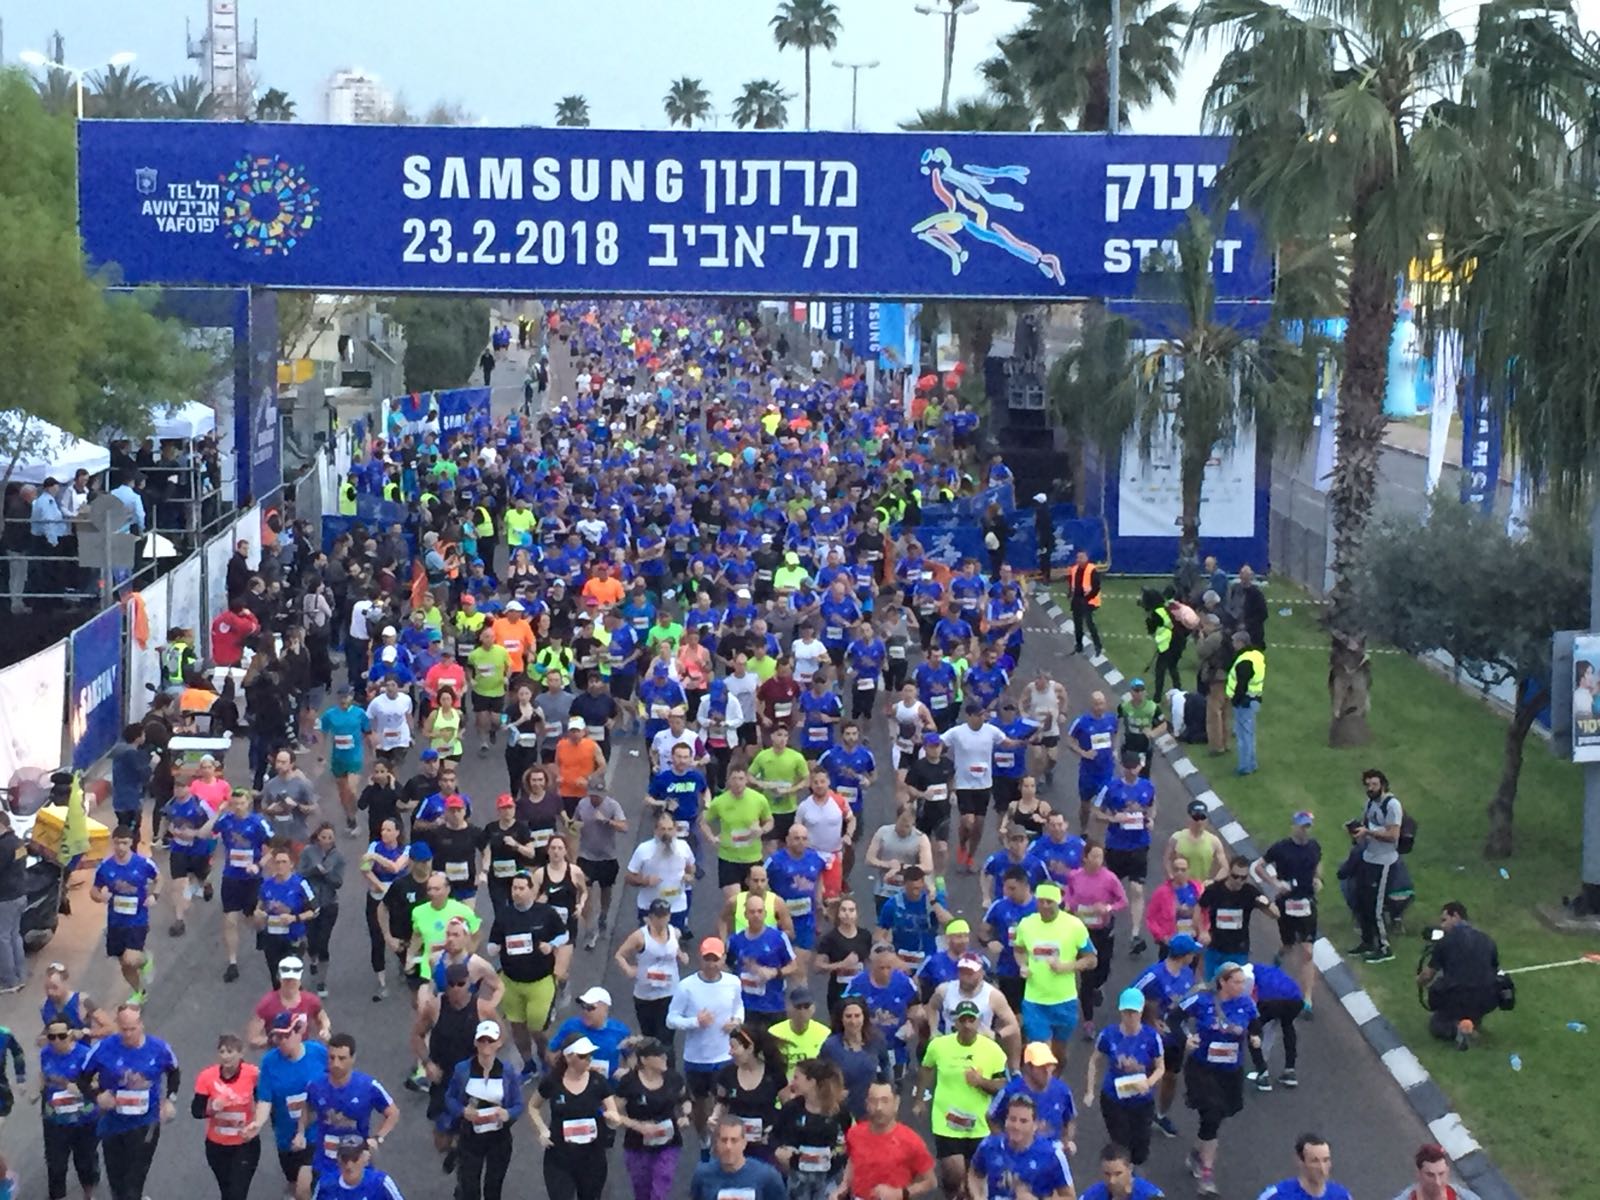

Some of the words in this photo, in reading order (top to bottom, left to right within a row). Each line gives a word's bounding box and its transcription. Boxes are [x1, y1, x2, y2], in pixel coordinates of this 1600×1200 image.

[402, 155, 683, 203] SAMSUNG
[700, 159, 858, 214] מרתון
[167, 183, 196, 200] TEL
[195, 180, 220, 200] תל
[1105, 163, 1240, 223] ינוק
[141, 200, 178, 216] AVIV
[179, 200, 220, 216] אביב
[156, 216, 196, 233] YAFO
[196, 217, 220, 233] יפו
[402, 218, 619, 266] 23.2.2018
[1103, 238, 1242, 273] STAT
